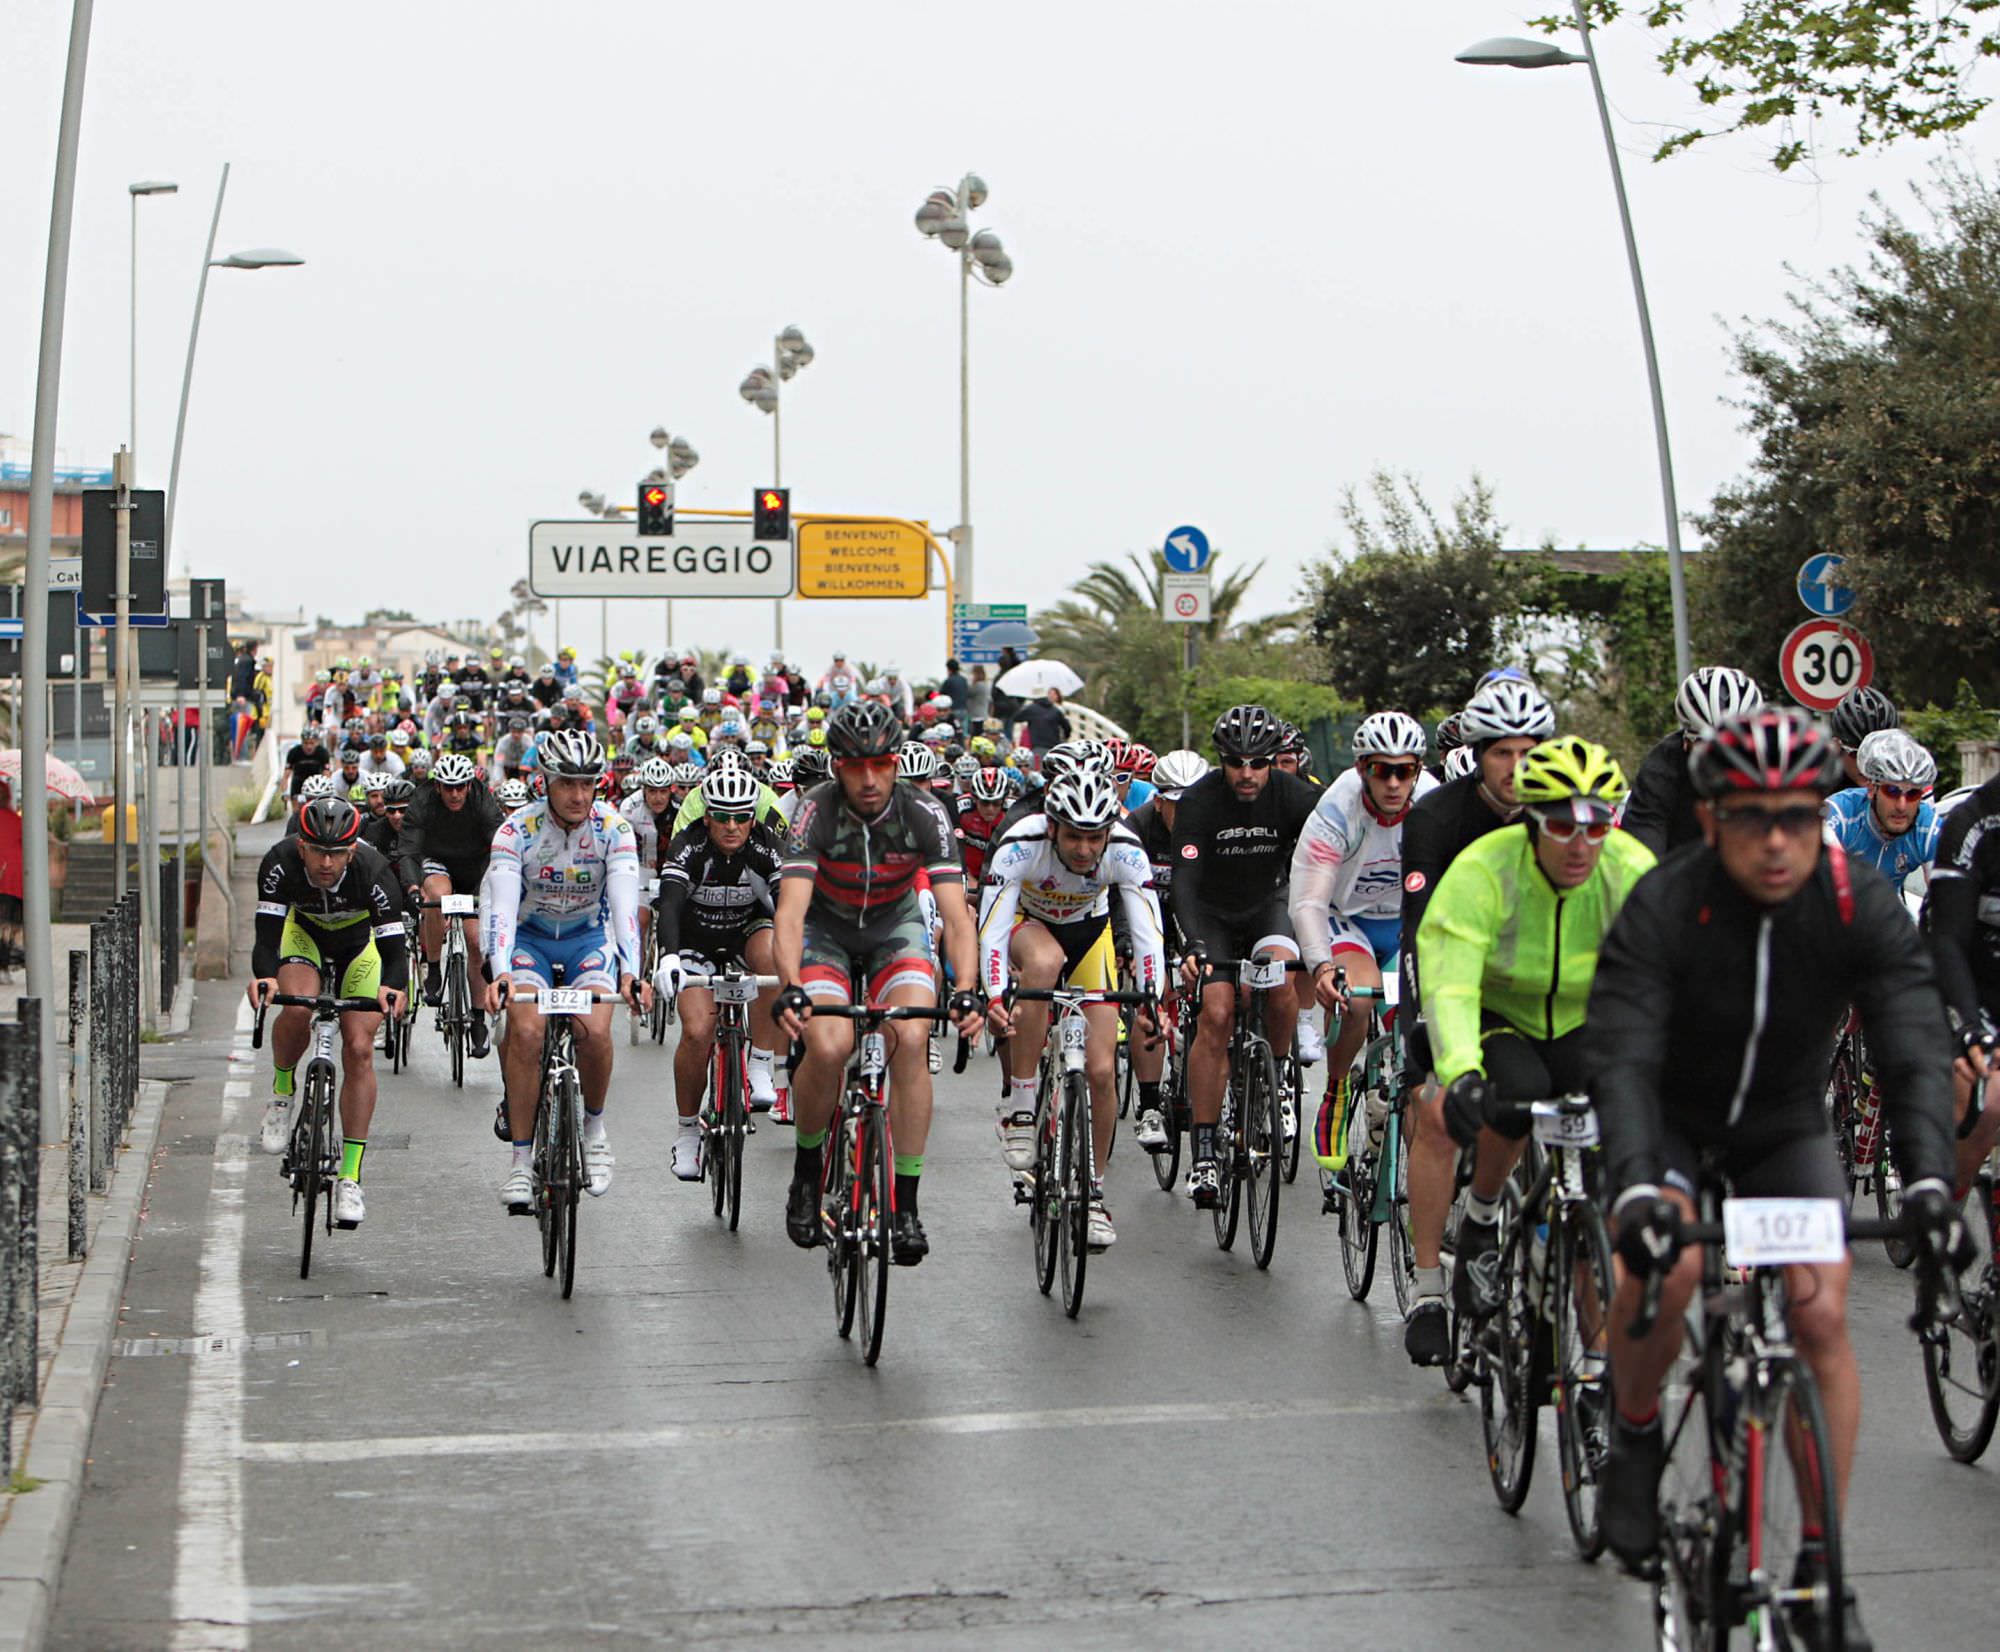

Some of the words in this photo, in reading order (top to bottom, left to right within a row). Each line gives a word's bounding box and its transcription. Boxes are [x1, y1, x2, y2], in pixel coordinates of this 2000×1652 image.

[825, 530, 900, 541] BENVENUTI
[831, 547, 896, 557] WELCOME
[552, 546, 772, 573] VIAREGGIO
[816, 580, 905, 590] WILLKOMMEN
[1803, 644, 1853, 686] 30
[1255, 966, 1269, 978] 71
[550, 991, 579, 1003] 872
[729, 989, 744, 997] 12
[1065, 1030, 1082, 1043] 69
[1755, 1214, 1808, 1240] 107
